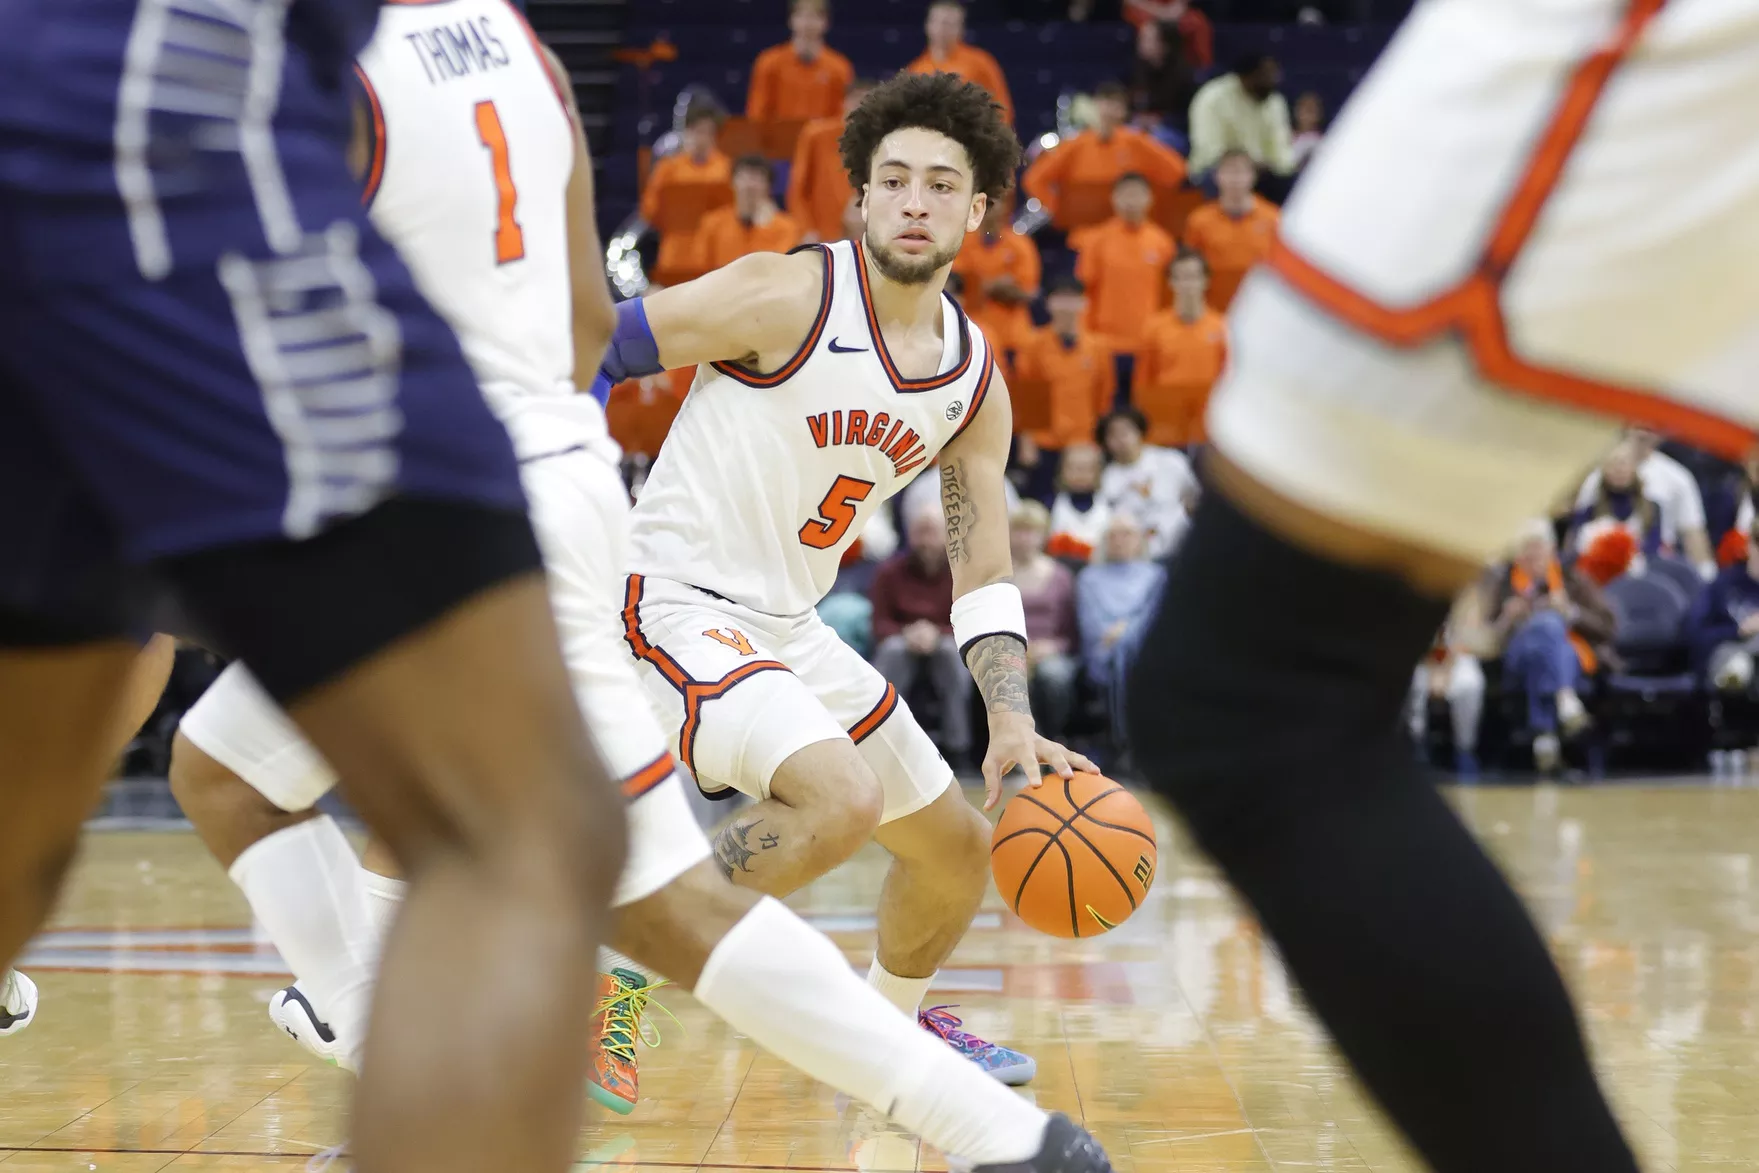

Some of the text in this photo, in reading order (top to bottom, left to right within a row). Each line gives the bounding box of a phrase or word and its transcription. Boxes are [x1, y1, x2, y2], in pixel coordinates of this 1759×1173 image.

[403, 15, 510, 85] THOMAS
[473, 99, 526, 267] 1
[806, 410, 927, 478] VIRGINIA
[798, 474, 875, 549] 5
[942, 464, 961, 563] DIFFERENT
